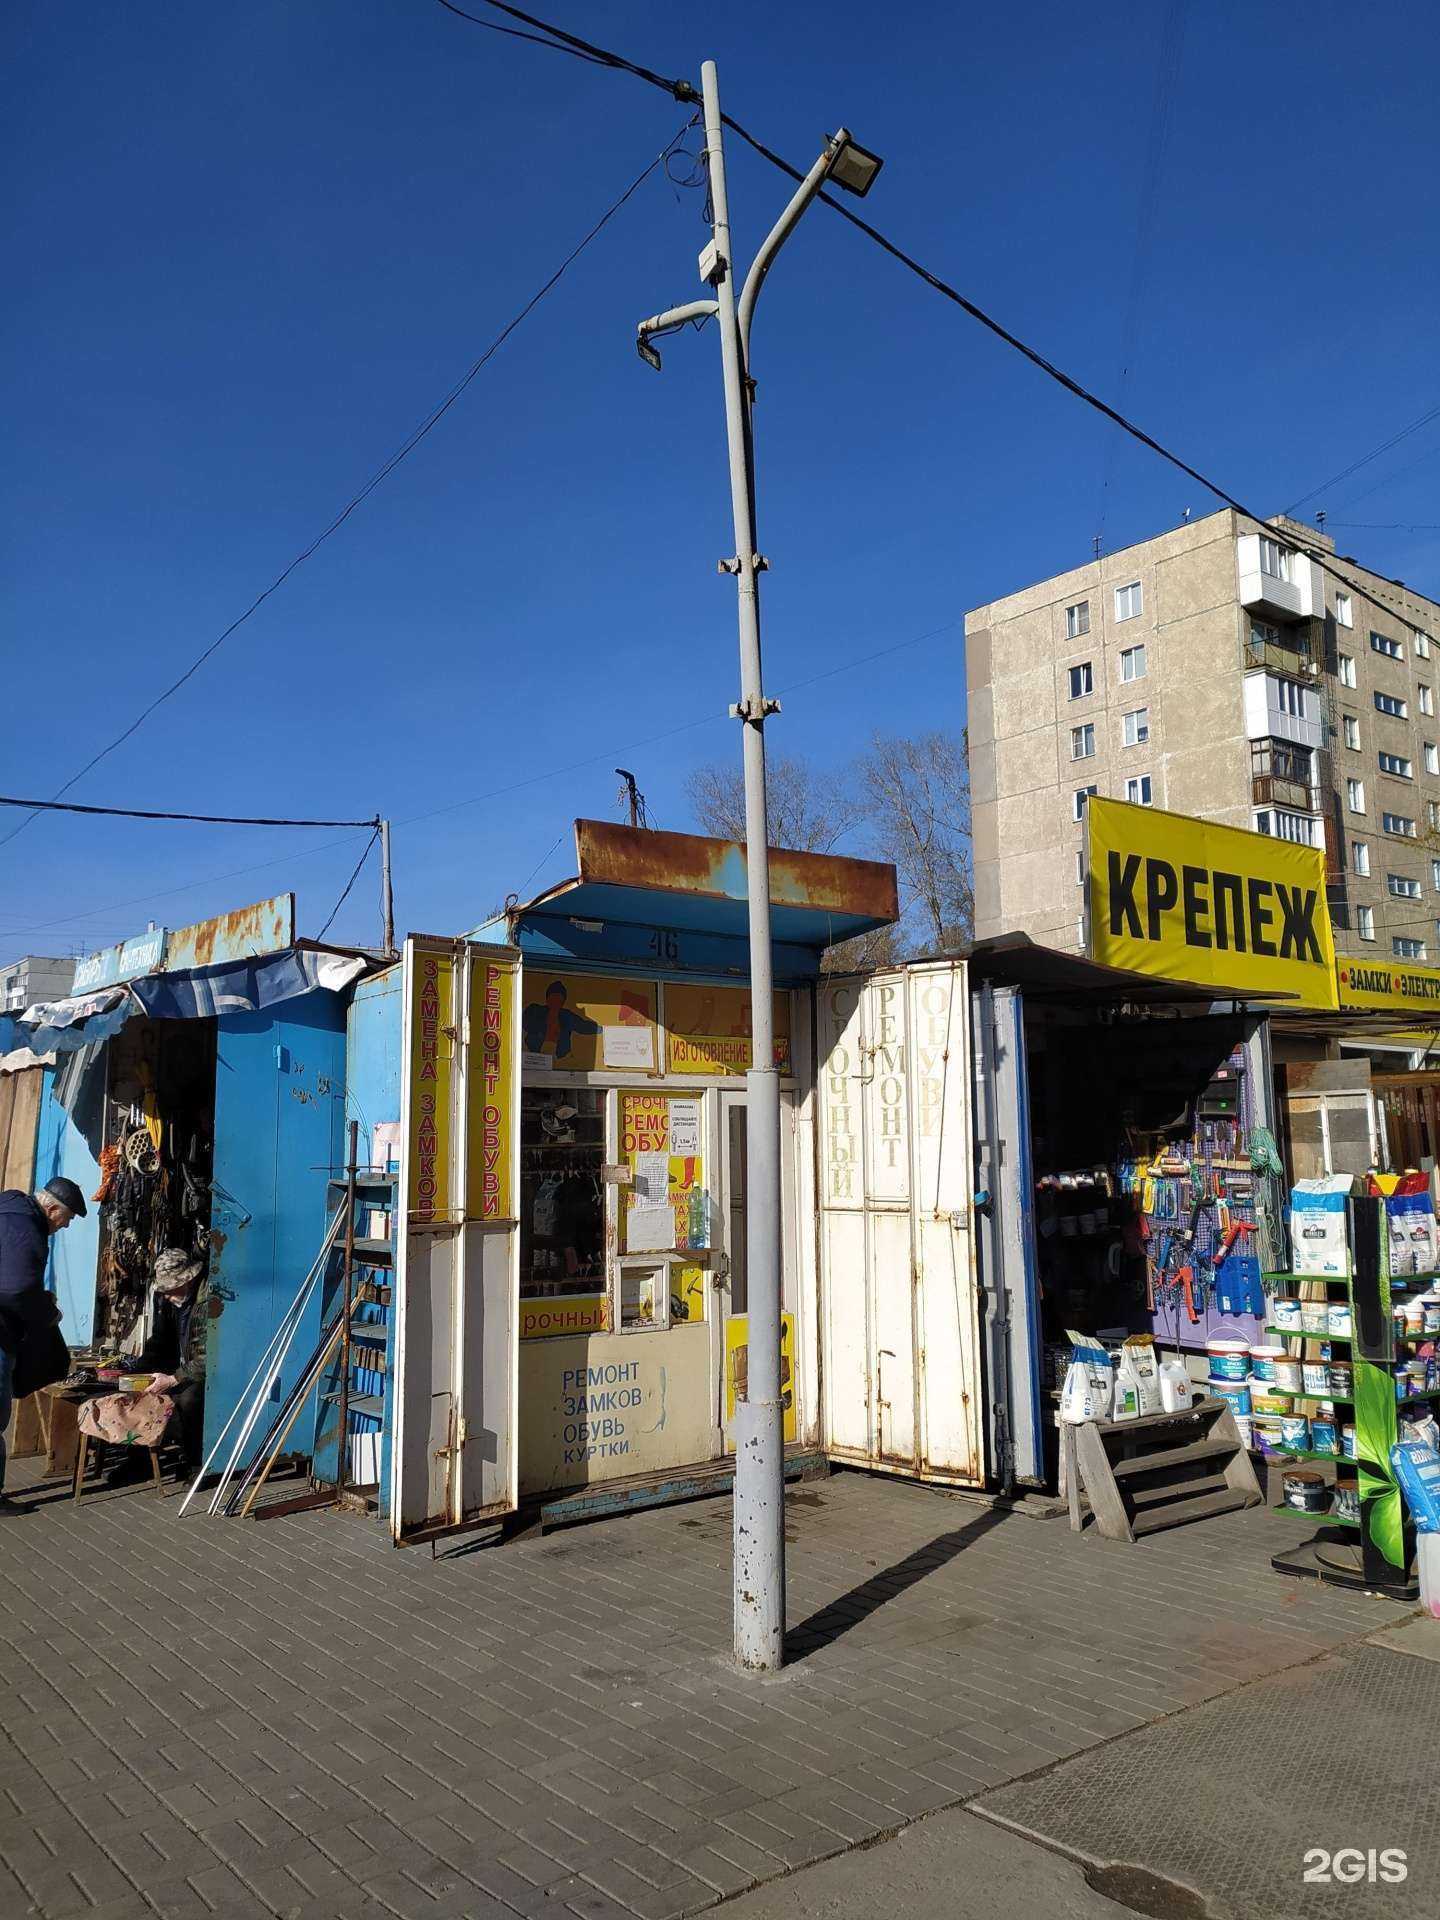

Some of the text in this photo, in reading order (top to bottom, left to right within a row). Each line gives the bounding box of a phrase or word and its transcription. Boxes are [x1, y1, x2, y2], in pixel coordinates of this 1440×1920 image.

[1108, 850, 1324, 963] КРЕПЕЖ
[1349, 967, 1393, 995] ЗАМКИ
[672, 1039, 748, 1063] ИЗГОТОВЛЕНИЕ
[417, 959, 439, 1219] ЗАМЕНА ЗАМКОВ
[481, 964, 502, 1217] РЕМОНТ ОБУВИ
[879, 986, 906, 1168] РЕМОНТ
[622, 1114, 669, 1131] РЕМО
[622, 1132, 667, 1152] ОБУ
[523, 1303, 609, 1336] рочный
[562, 1362, 640, 1391] РЕМОНТ
[563, 1388, 642, 1417] ЗАМКОВ
[563, 1417, 626, 1444] ОБУВЬ
[563, 1440, 630, 1465] КУРТКИ
